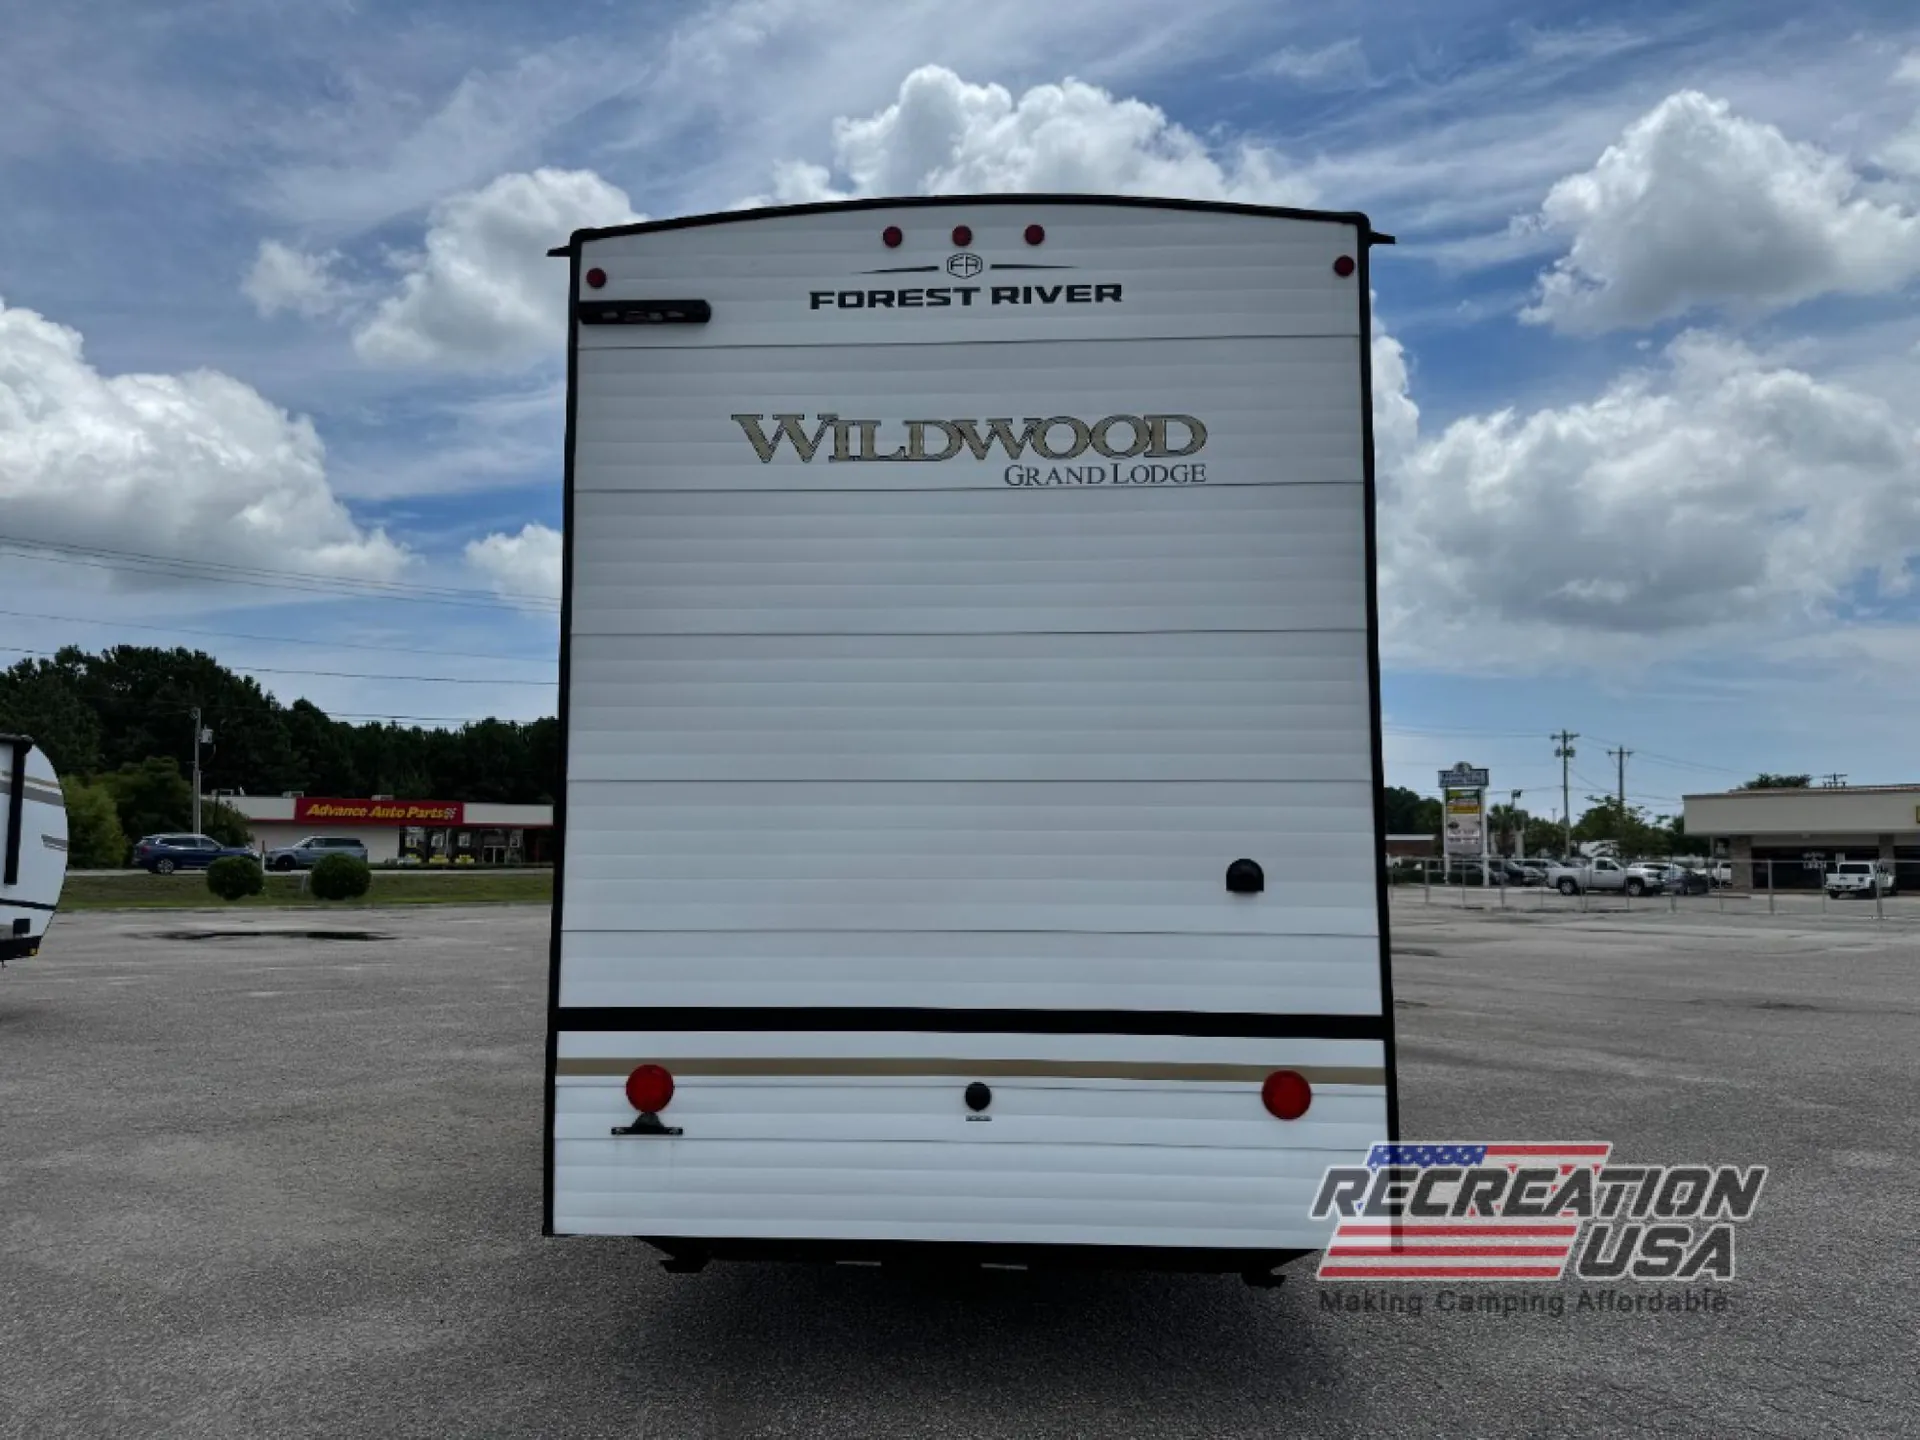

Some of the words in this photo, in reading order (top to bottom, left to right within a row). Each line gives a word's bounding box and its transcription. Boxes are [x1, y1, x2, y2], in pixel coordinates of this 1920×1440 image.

[809, 286, 981, 310] FOREST
[991, 284, 1123, 305] RIVER
[731, 413, 1208, 463] WILDWOOD
[1004, 464, 1106, 487] GRAND
[1110, 462, 1207, 485] LODGE
[306, 804, 367, 818] Advance
[369, 805, 405, 818] Auto
[406, 806, 445, 819] Parts
